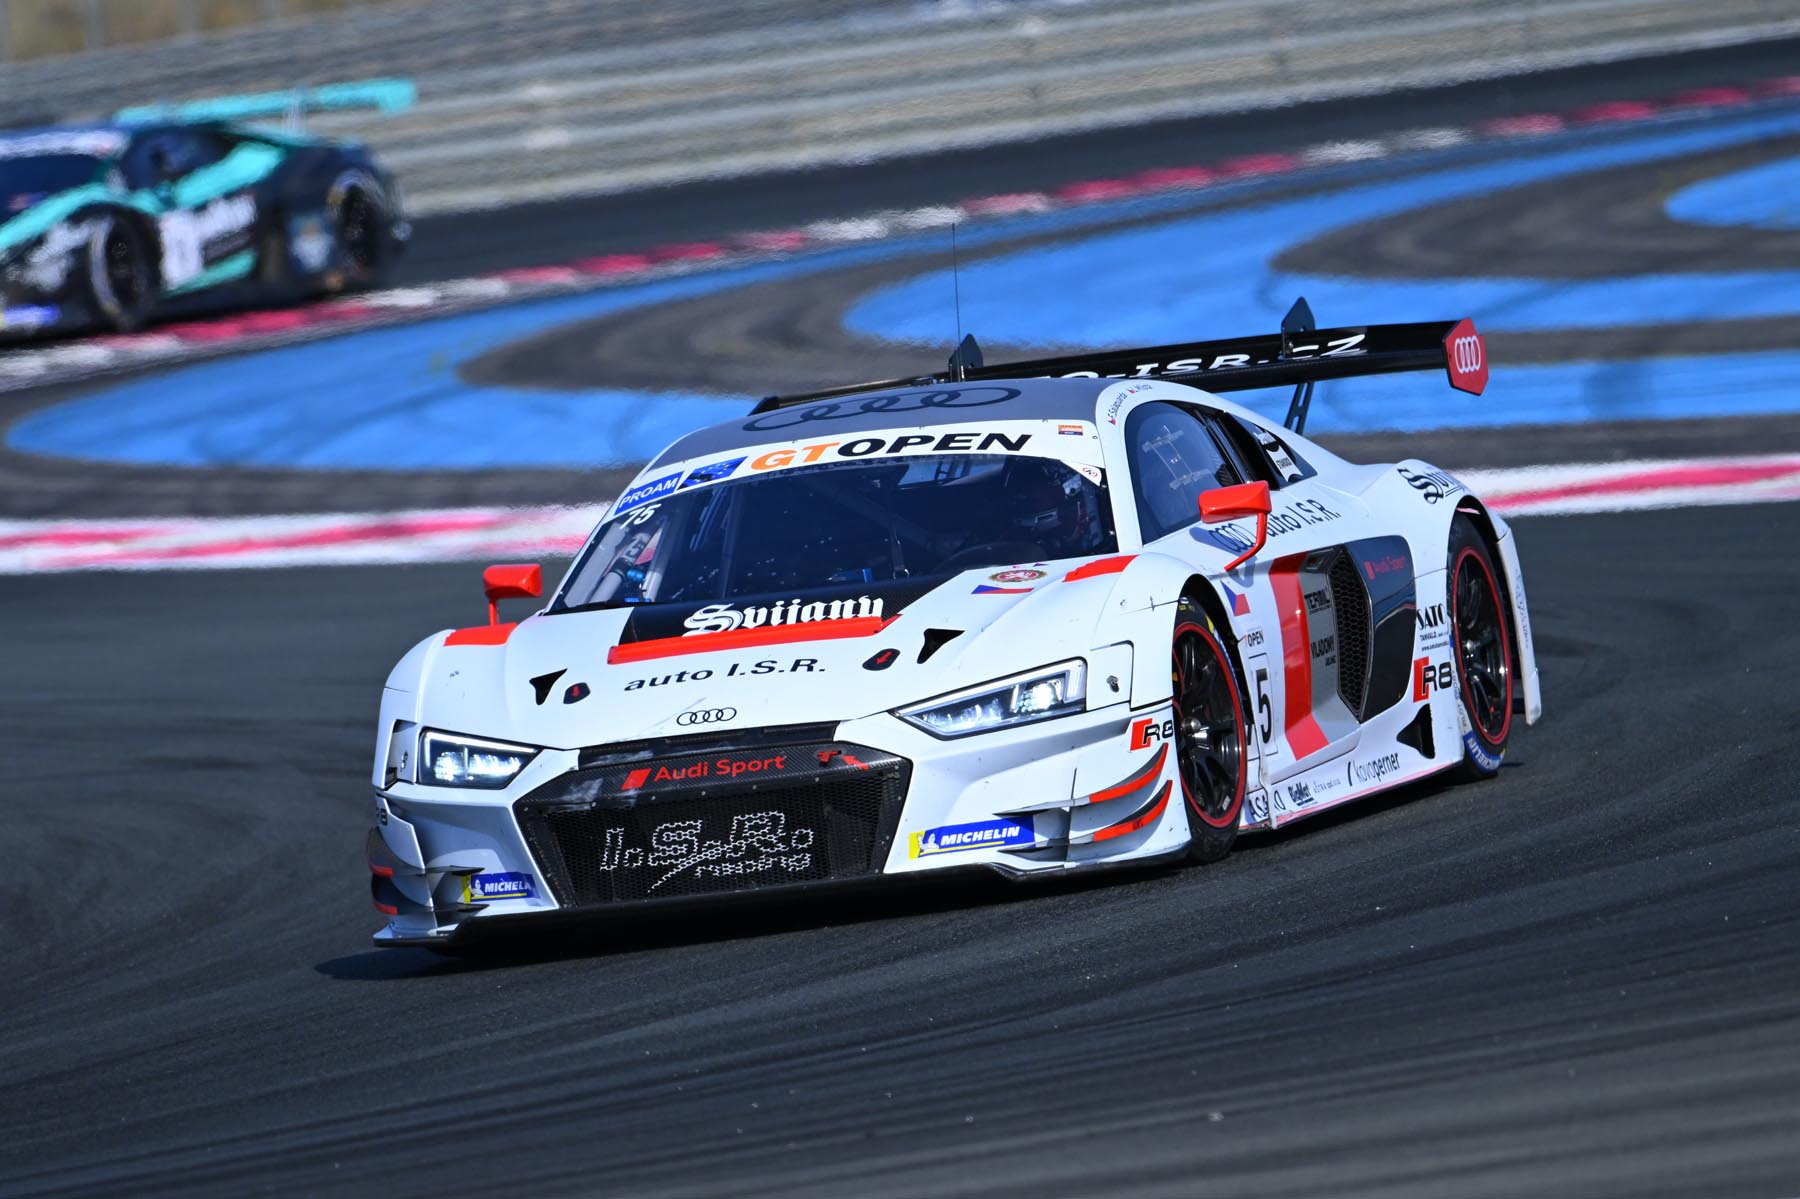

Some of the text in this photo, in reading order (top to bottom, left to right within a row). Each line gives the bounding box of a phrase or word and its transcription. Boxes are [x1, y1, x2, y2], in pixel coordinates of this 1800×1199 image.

[620, 476, 678, 508] PROAM
[620, 503, 661, 529] 75
[682, 595, 884, 637] Svijany
[624, 658, 826, 691] auto I.S.R.
[1422, 662, 1453, 694] R8
[1143, 719, 1174, 745] R8
[653, 755, 785, 782] Audi Sport
[940, 826, 1020, 846] MICHELIN
